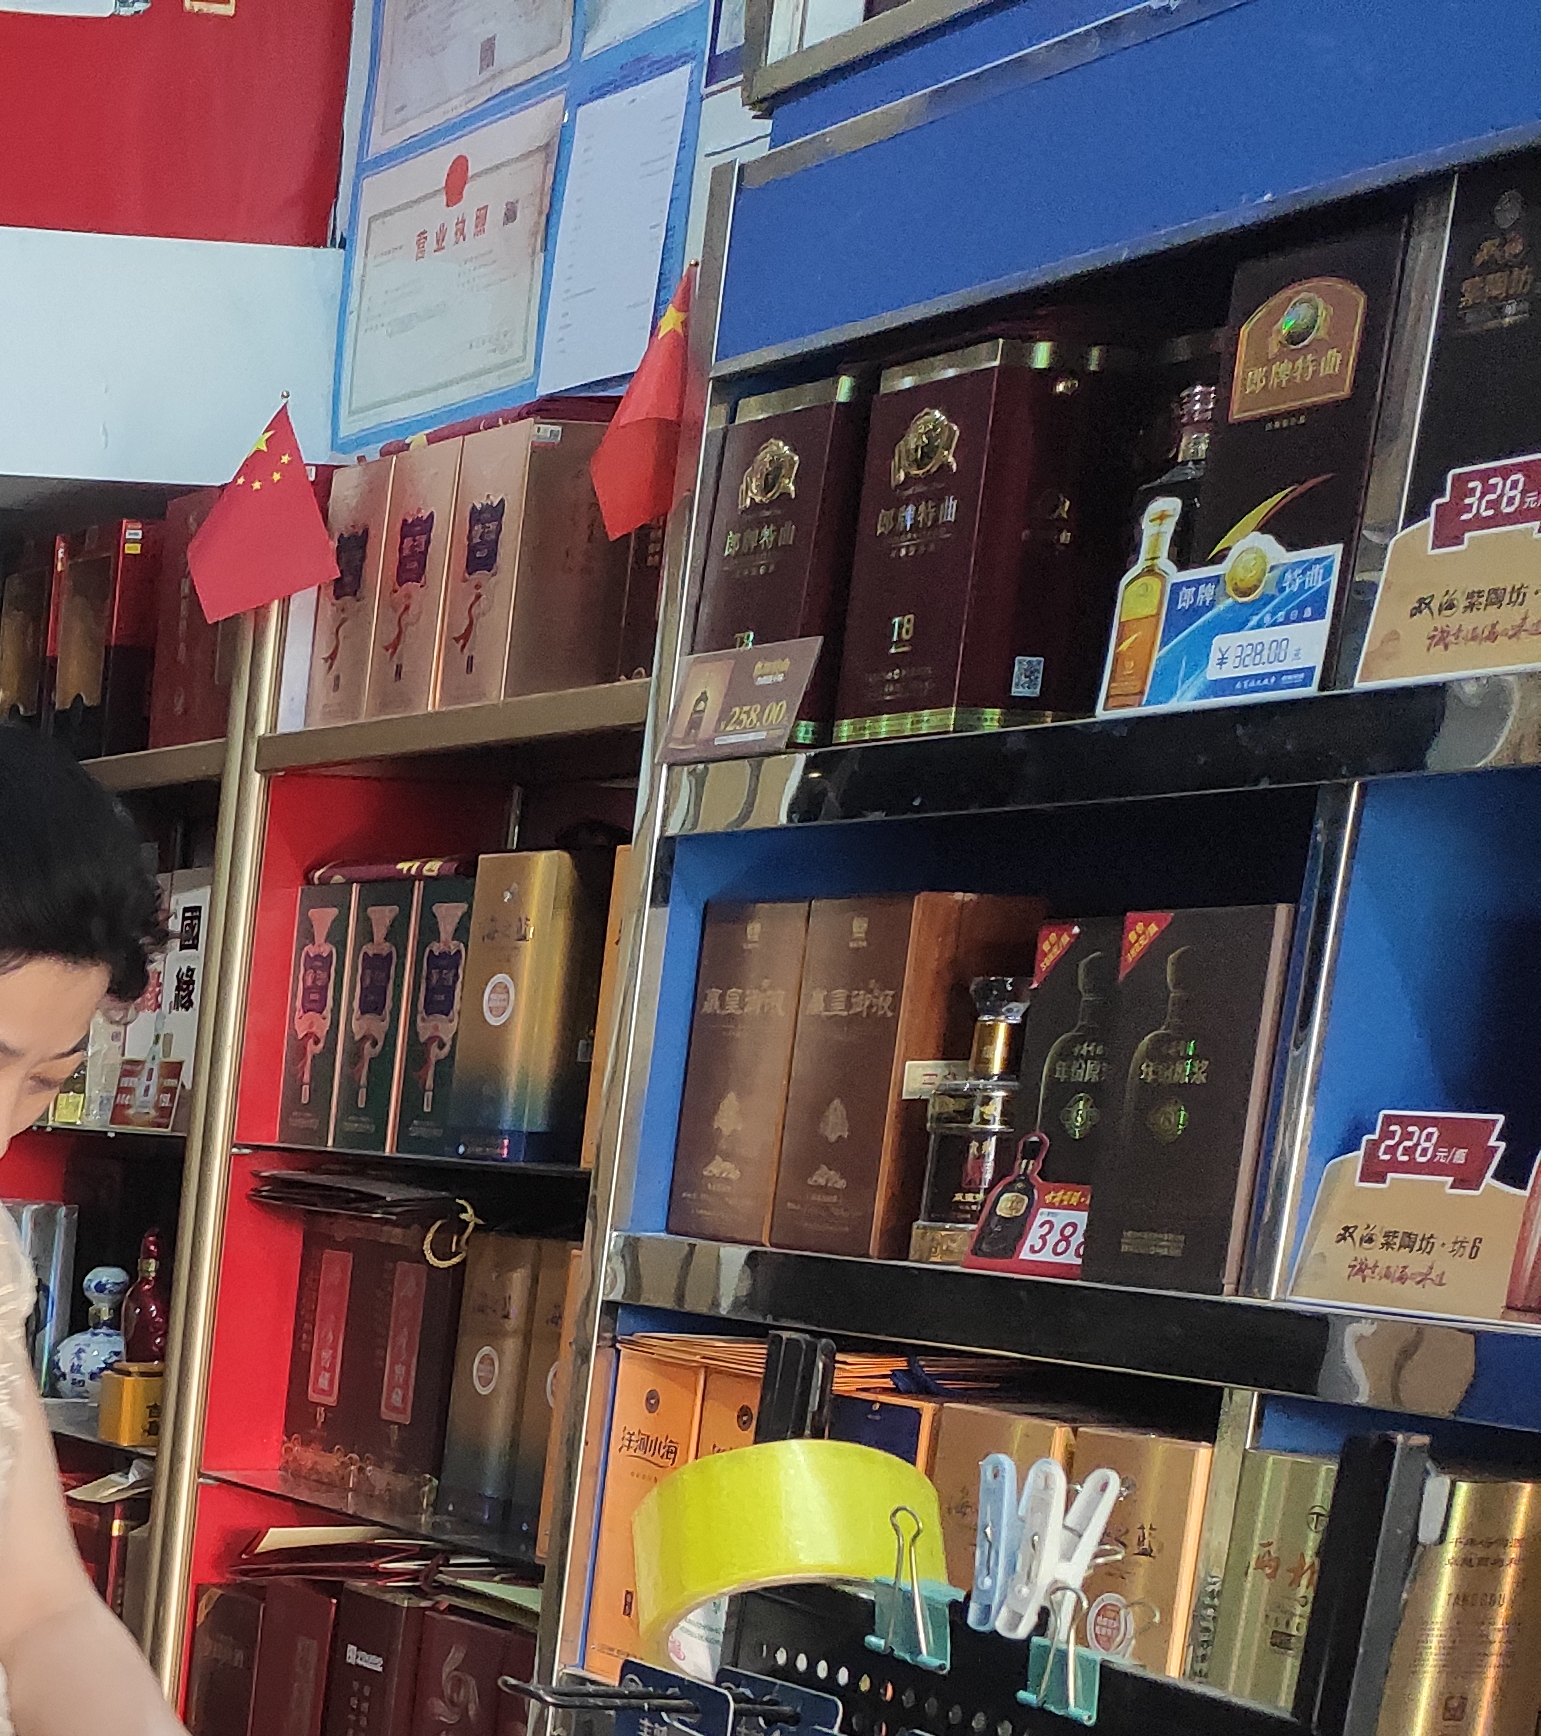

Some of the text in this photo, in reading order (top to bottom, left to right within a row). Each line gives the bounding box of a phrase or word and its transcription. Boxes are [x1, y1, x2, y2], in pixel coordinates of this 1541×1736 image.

[415, 203, 489, 262] 营业执照
[1053, 1058, 1113, 1084] 年份原
